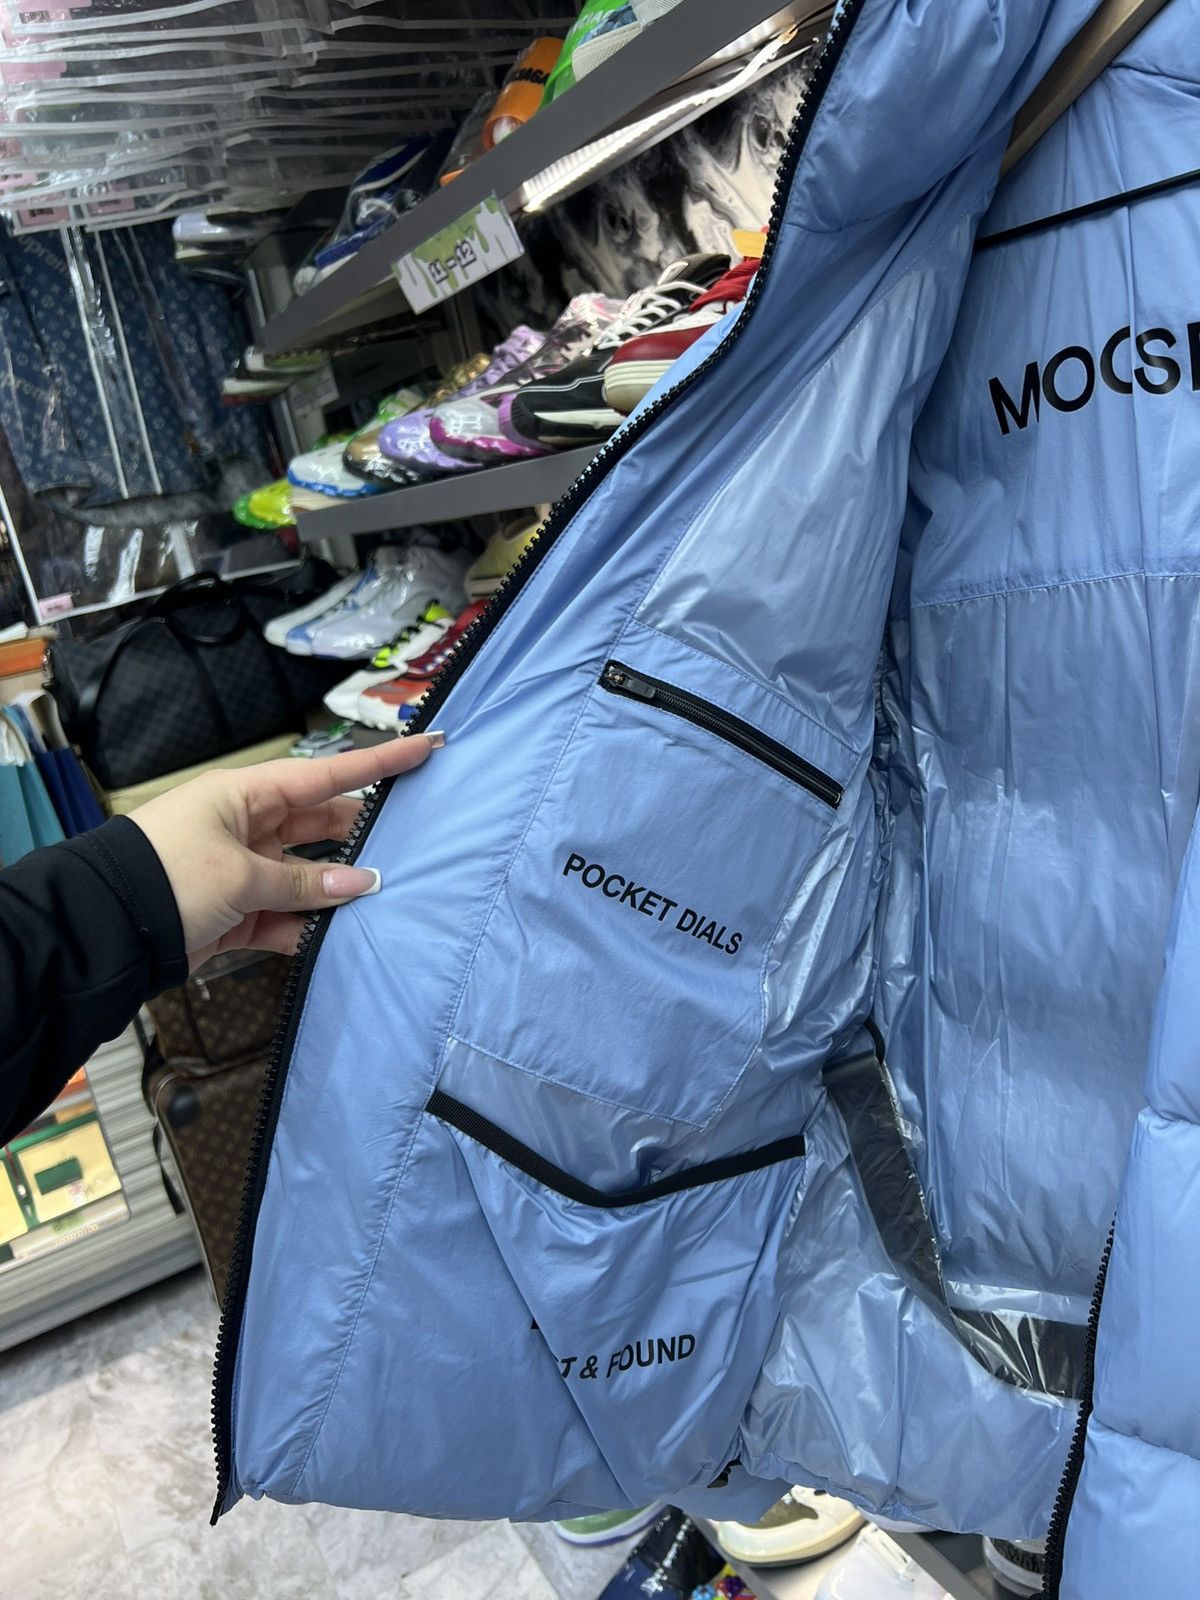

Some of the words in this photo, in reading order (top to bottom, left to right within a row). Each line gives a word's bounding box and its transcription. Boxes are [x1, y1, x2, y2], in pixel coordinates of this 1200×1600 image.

[562, 852, 678, 922] POCKET
[676, 908, 743, 955] DIALS
[579, 1354, 599, 1379] &
[606, 1333, 696, 1379] FOUND
